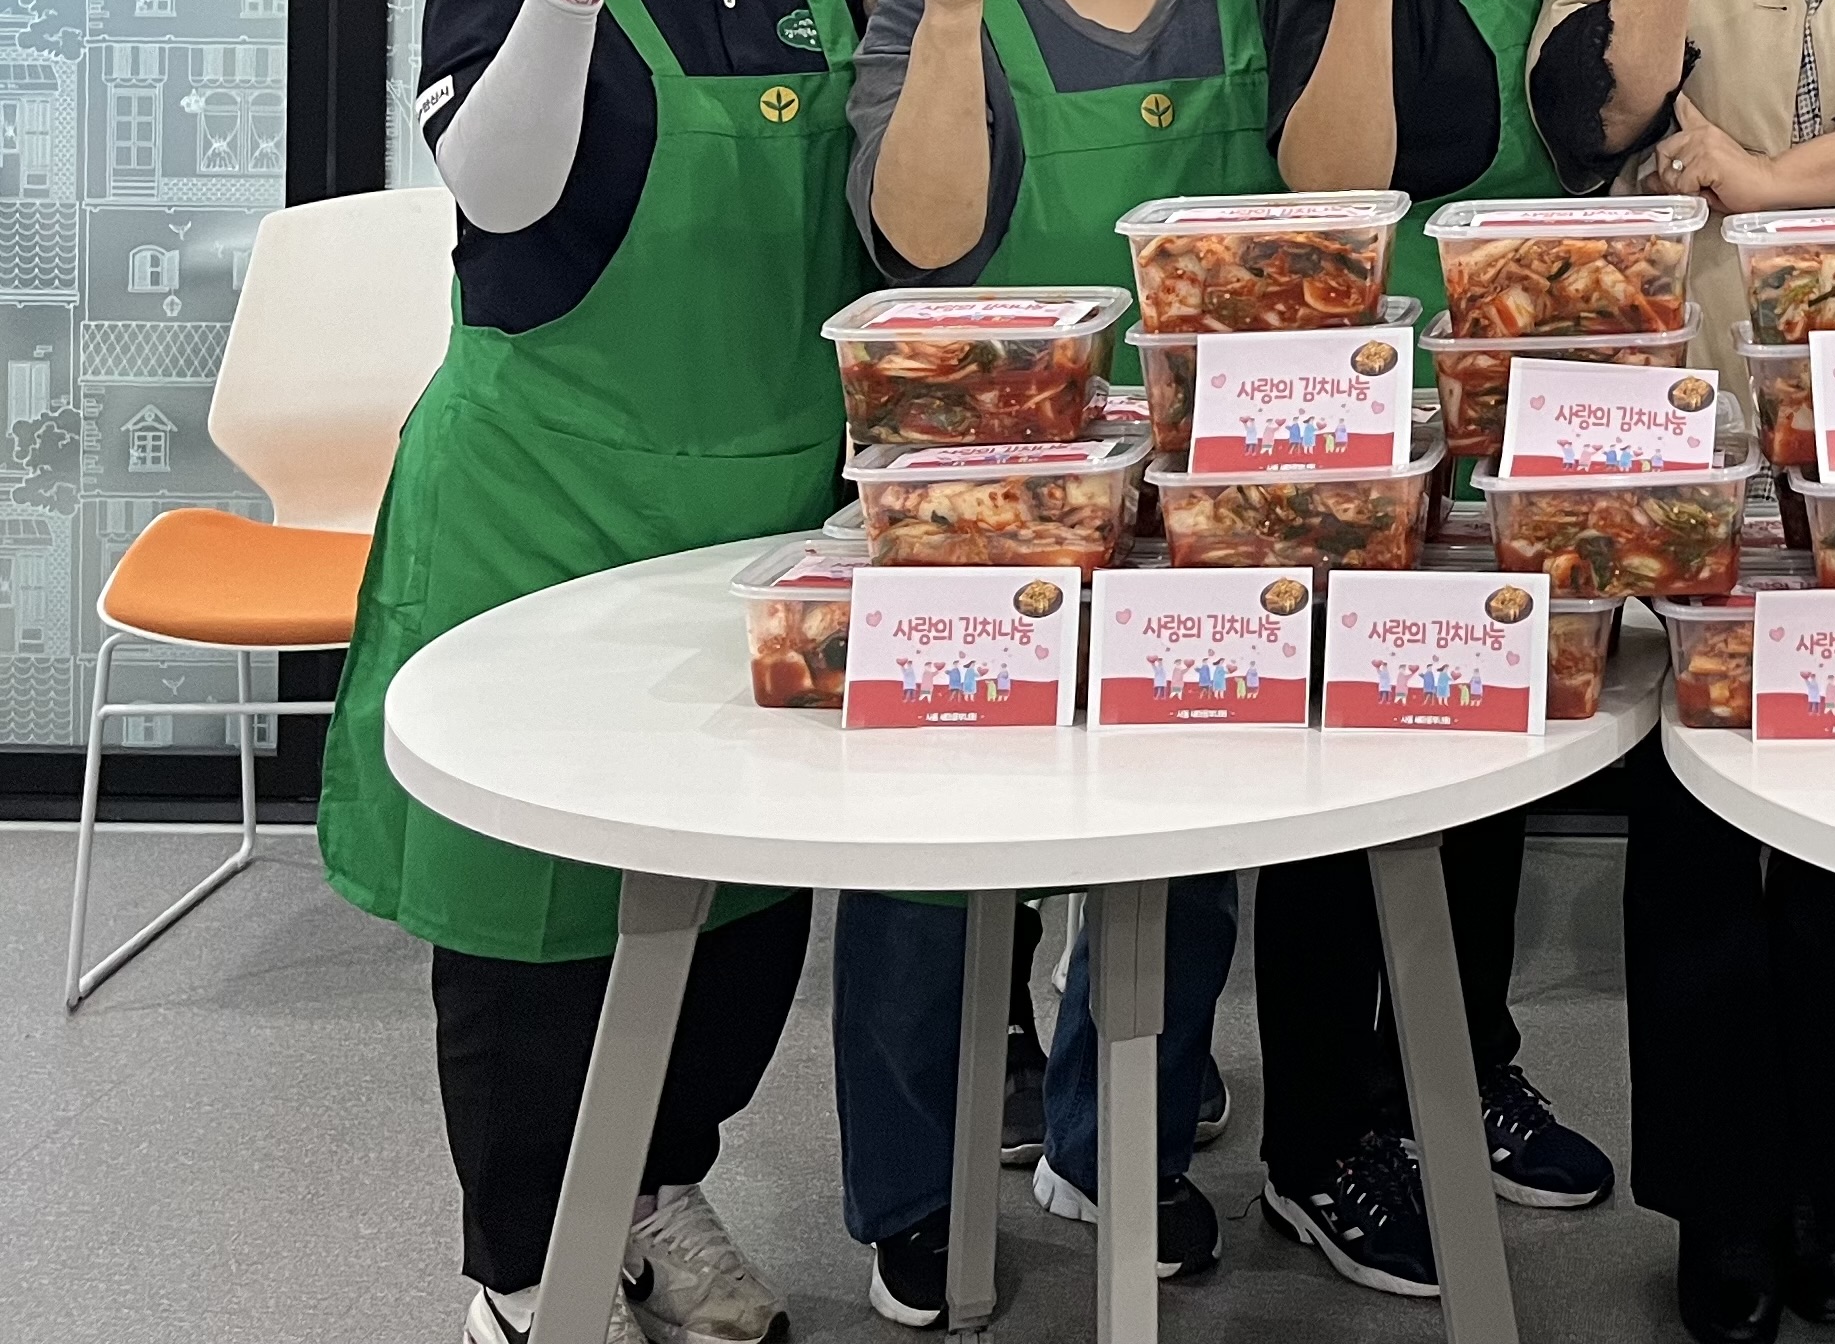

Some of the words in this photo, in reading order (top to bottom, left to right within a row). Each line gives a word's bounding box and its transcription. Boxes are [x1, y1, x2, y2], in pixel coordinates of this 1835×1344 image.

[1236, 377, 1294, 405] 사랑의
[1299, 375, 1371, 403] 김치나눔
[1554, 403, 1611, 431] 사랑의
[1616, 406, 1688, 436] 김치나눔
[892, 616, 953, 646] 사랑의
[959, 616, 1035, 646] 김치나눔
[1142, 613, 1202, 644] 사랑의
[1206, 614, 1282, 644] 김치나눔
[1367, 619, 1427, 647] 사랑의
[1431, 619, 1506, 651] 김치나눔
